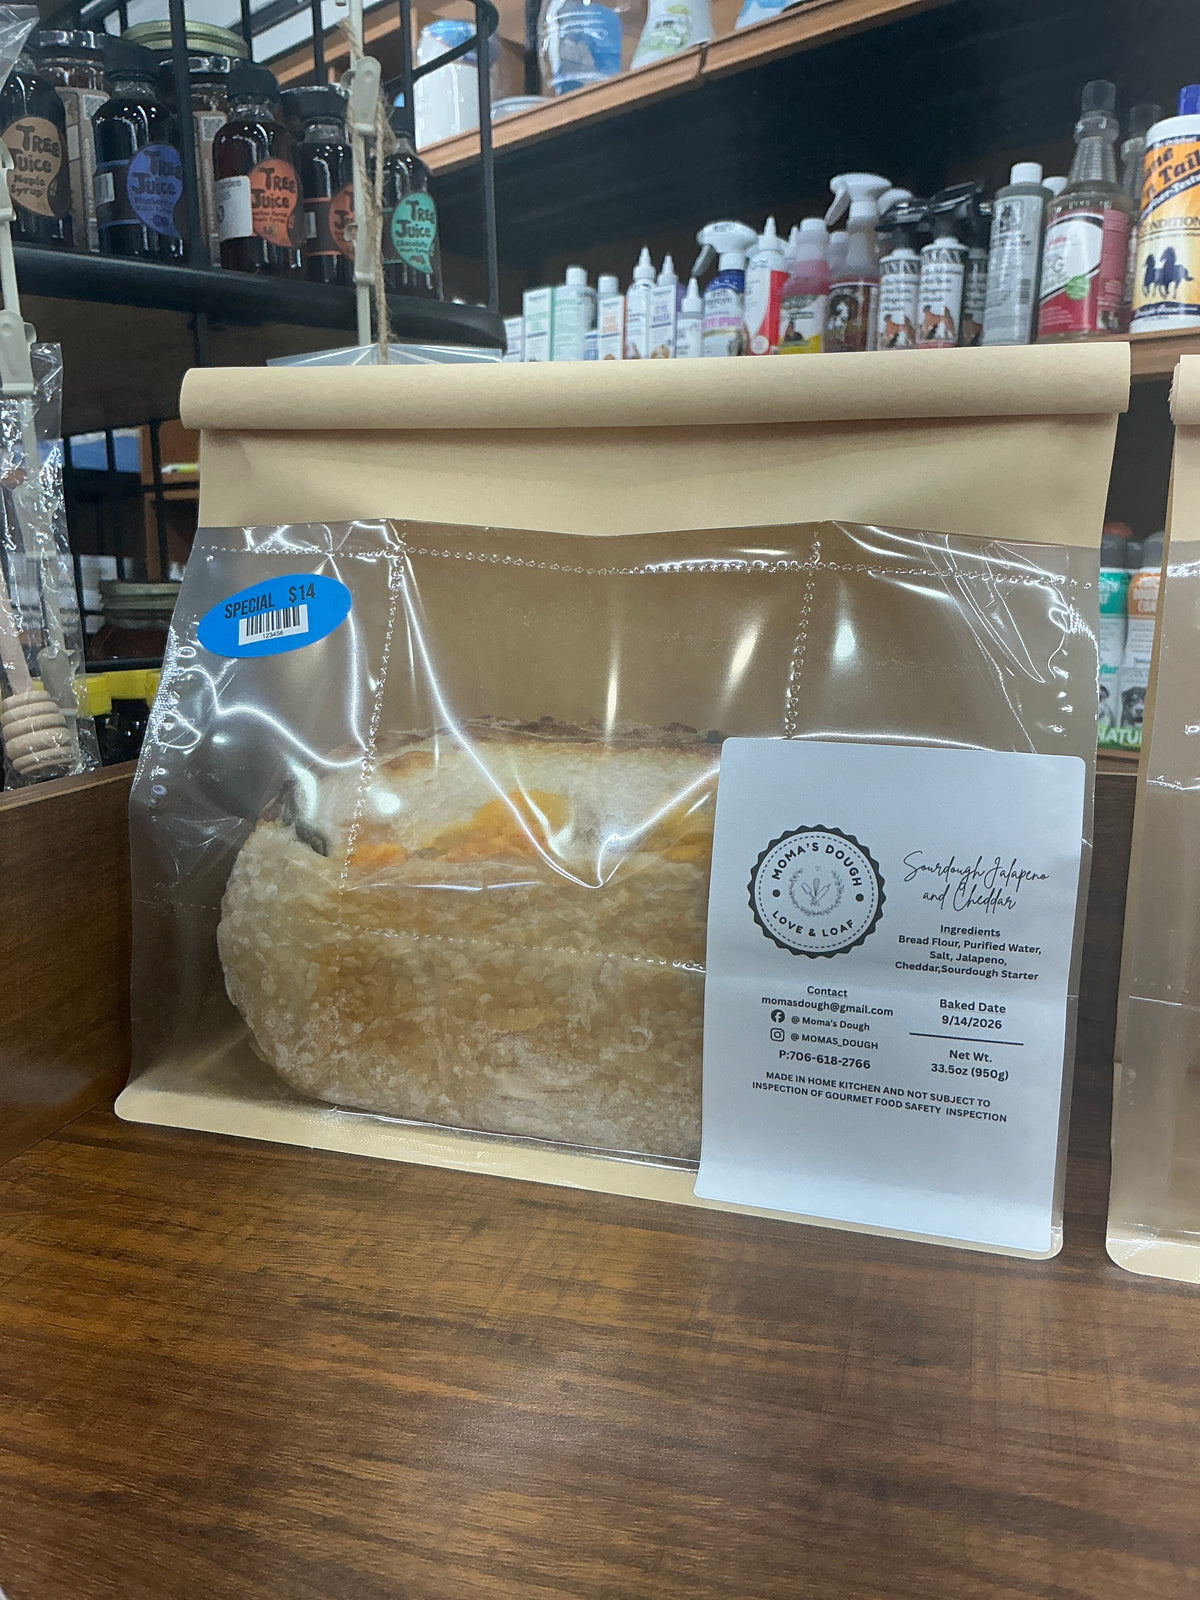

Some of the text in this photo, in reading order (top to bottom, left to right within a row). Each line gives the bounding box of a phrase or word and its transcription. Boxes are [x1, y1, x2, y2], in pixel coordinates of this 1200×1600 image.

[259, 167, 297, 194] TREE
[251, 188, 290, 209] Juice
[395, 219, 431, 239] Juice
[224, 582, 316, 619] SPECIAL $14
[262, 630, 284, 639] 123456
[1098, 727, 1142, 745] NATU
[771, 842, 863, 887] MOMA'S DOUGH
[903, 850, 1050, 897] Sourdough Jalapeno
[922, 881, 1017, 914] and Cheddar
[772, 910, 854, 937] LOVE & LOAF
[940, 924, 1001, 938] Ingredients
[898, 935, 1042, 955] Bread Flour, Purified Water,
[929, 950, 1007, 967] Salt, Jalapeno,
[895, 961, 1039, 981] Cheddar,Sourdough Starter
[806, 985, 848, 998] Contact
[761, 996, 894, 1017] momasdough@gmail.com
[939, 998, 1007, 1014] Baked Date
[790, 1015, 870, 1033] @ Moma's Dough
[941, 1015, 1003, 1030] 9/14/2026
[790, 1032, 879, 1050] @ MOMAS_DOUGH
[778, 1049, 871, 1069] P:706-618-2766
[949, 1049, 993, 1063] Net Wt.
[931, 1063, 1009, 1082] 33.5oz (950g)
[766, 1071, 991, 1108] MADE IN HOME KITCHEN AND NOT SUBJECT TO
[752, 1081, 1007, 1122] INSPECTION OF GOURMET FOOD SAFETY INSPECTION
